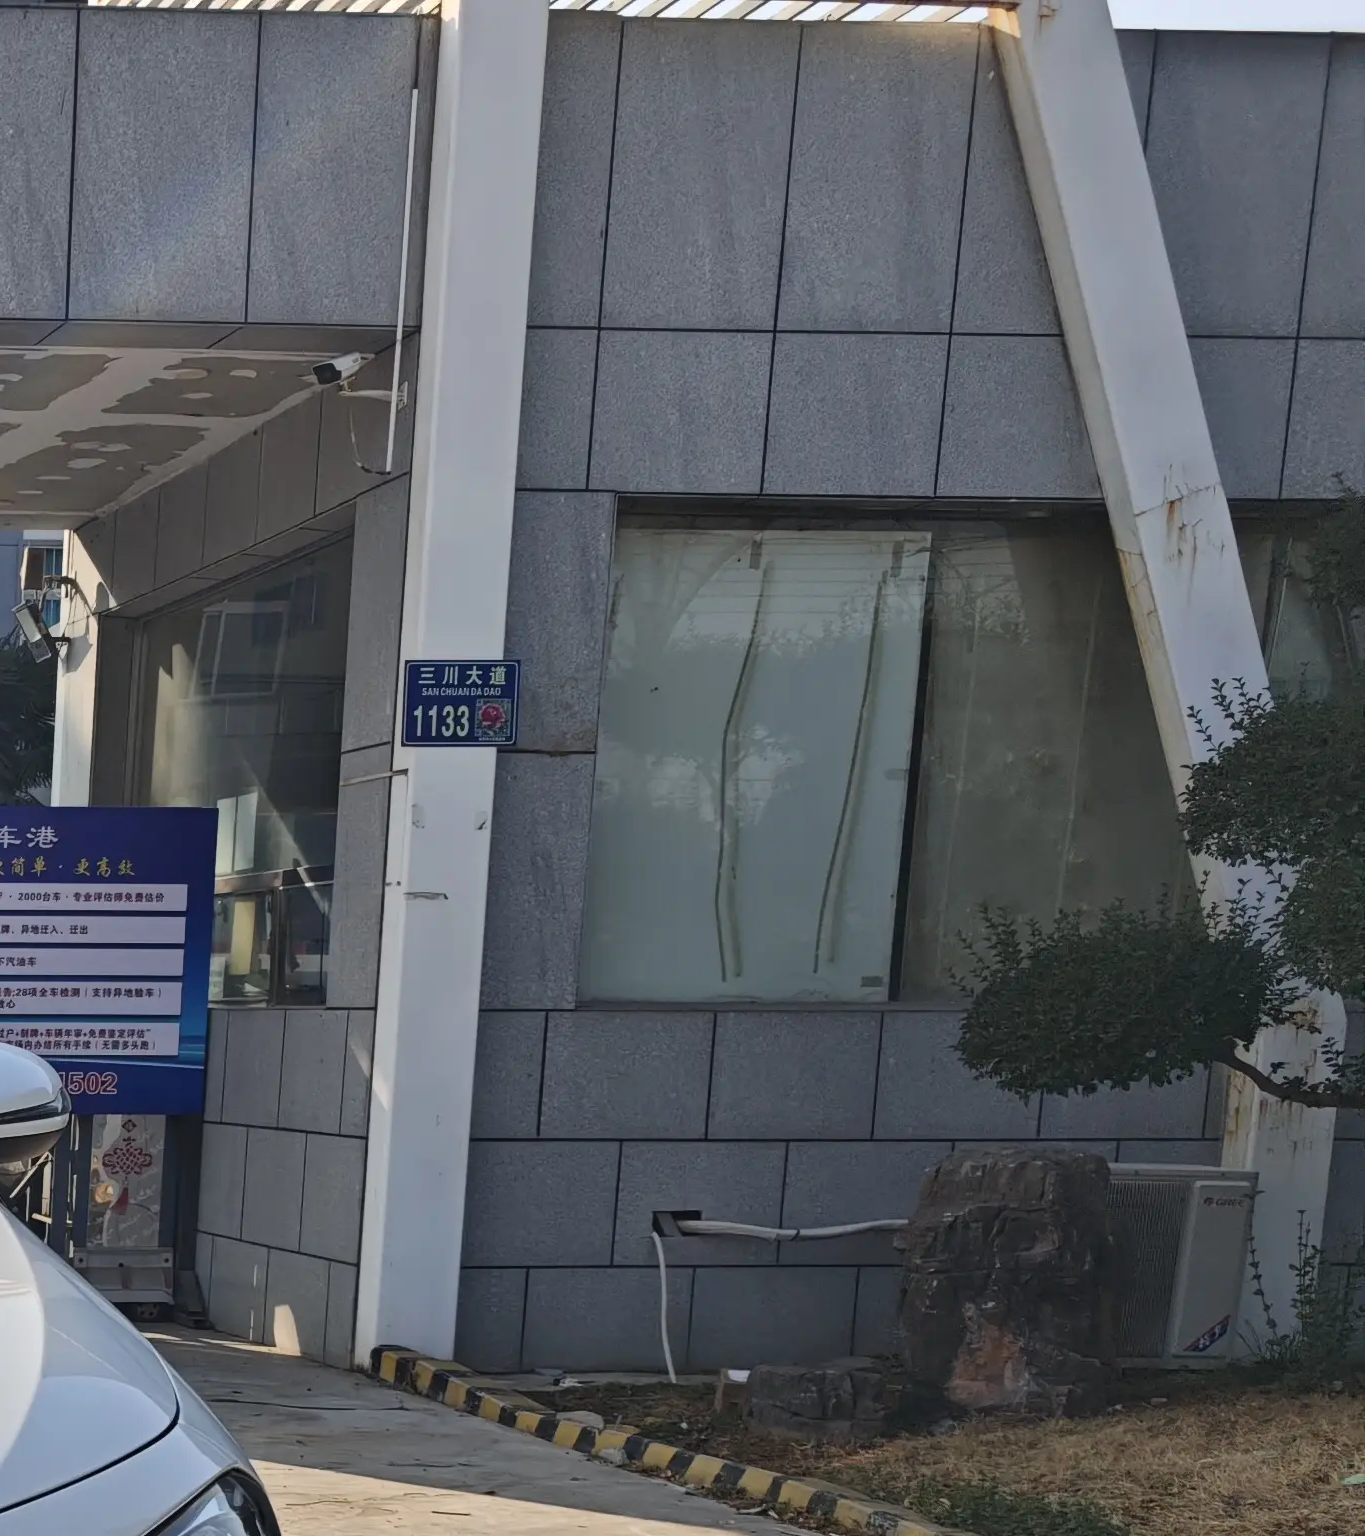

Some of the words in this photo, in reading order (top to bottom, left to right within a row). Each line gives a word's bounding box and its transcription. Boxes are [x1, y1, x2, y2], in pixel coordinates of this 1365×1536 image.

[417, 665, 507, 685] 三川大道
[421, 687, 440, 696] SAN
[440, 687, 470, 696] CHUAN
[470, 687, 483, 696] DA
[483, 687, 502, 696] DAO
[413, 705, 470, 737] 1133
[58, 1072, 118, 1094] 502
